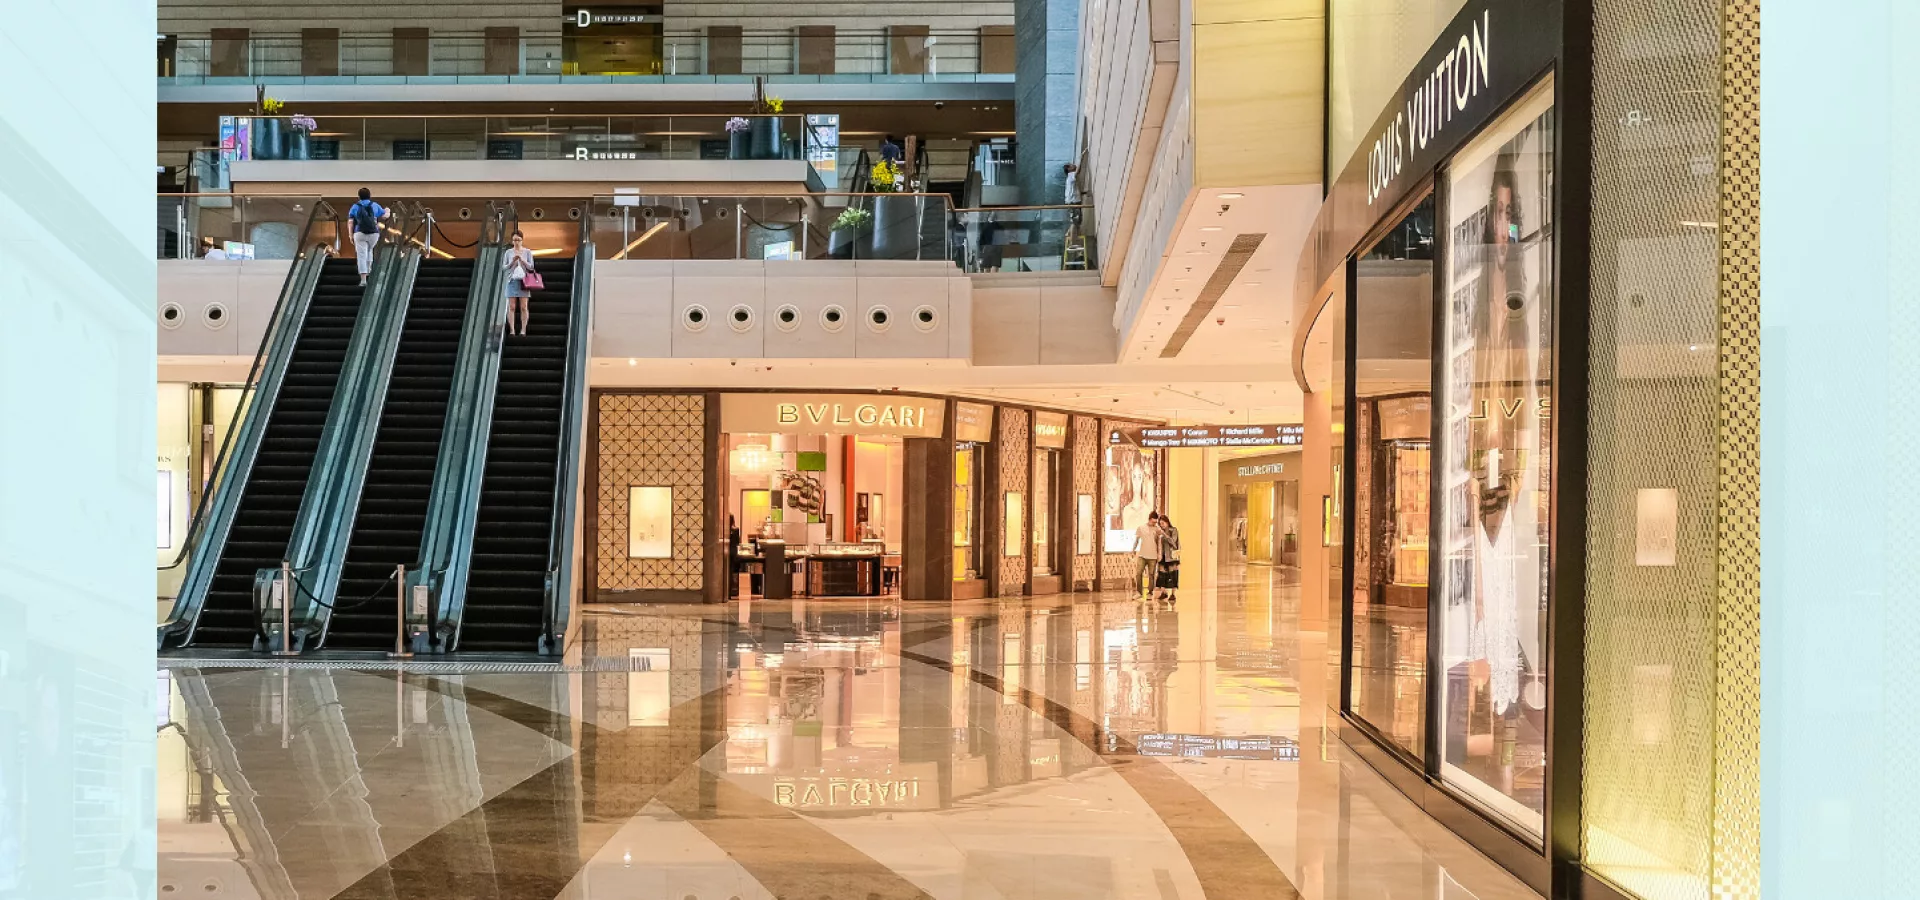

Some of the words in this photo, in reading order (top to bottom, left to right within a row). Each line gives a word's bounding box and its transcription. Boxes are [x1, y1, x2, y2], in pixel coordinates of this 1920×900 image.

[578, 10, 590, 27] D
[1368, 111, 1402, 206] LOUIS
[1407, 9, 1489, 162] VUITTON
[777, 403, 926, 428] BVLGARI
